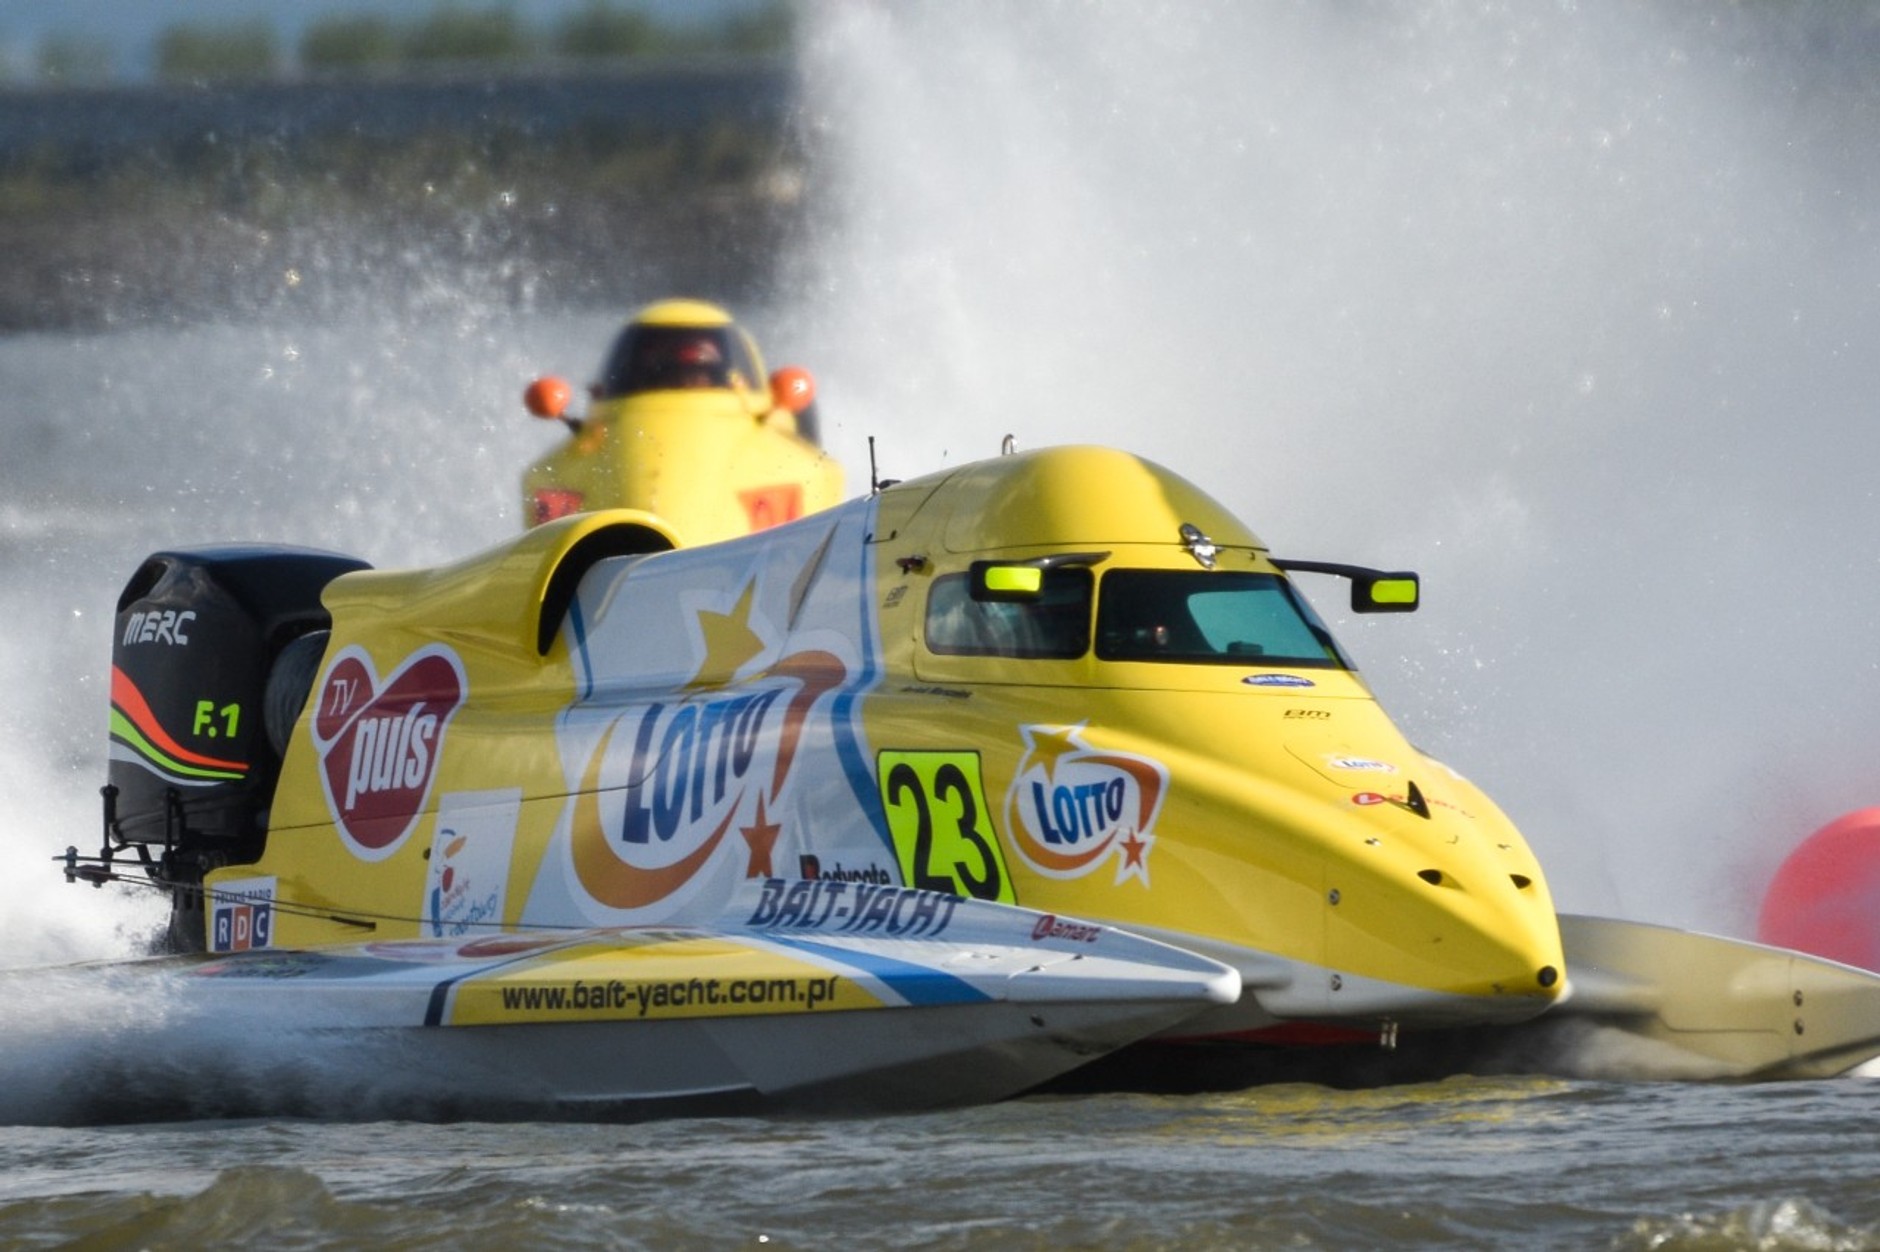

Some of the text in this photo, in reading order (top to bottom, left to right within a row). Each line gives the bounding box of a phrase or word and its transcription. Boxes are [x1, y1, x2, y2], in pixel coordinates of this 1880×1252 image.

[123, 610, 197, 646] MERC
[329, 678, 359, 716] TV
[345, 701, 438, 810] puls
[622, 687, 787, 844] LOTTO
[887, 763, 1000, 902] 23
[1032, 776, 1125, 844] LOTTO
[219, 911, 267, 944] RDC
[746, 878, 966, 936] BALT-YACHT
[503, 975, 840, 1017] www.balt-yacht.com.pl
